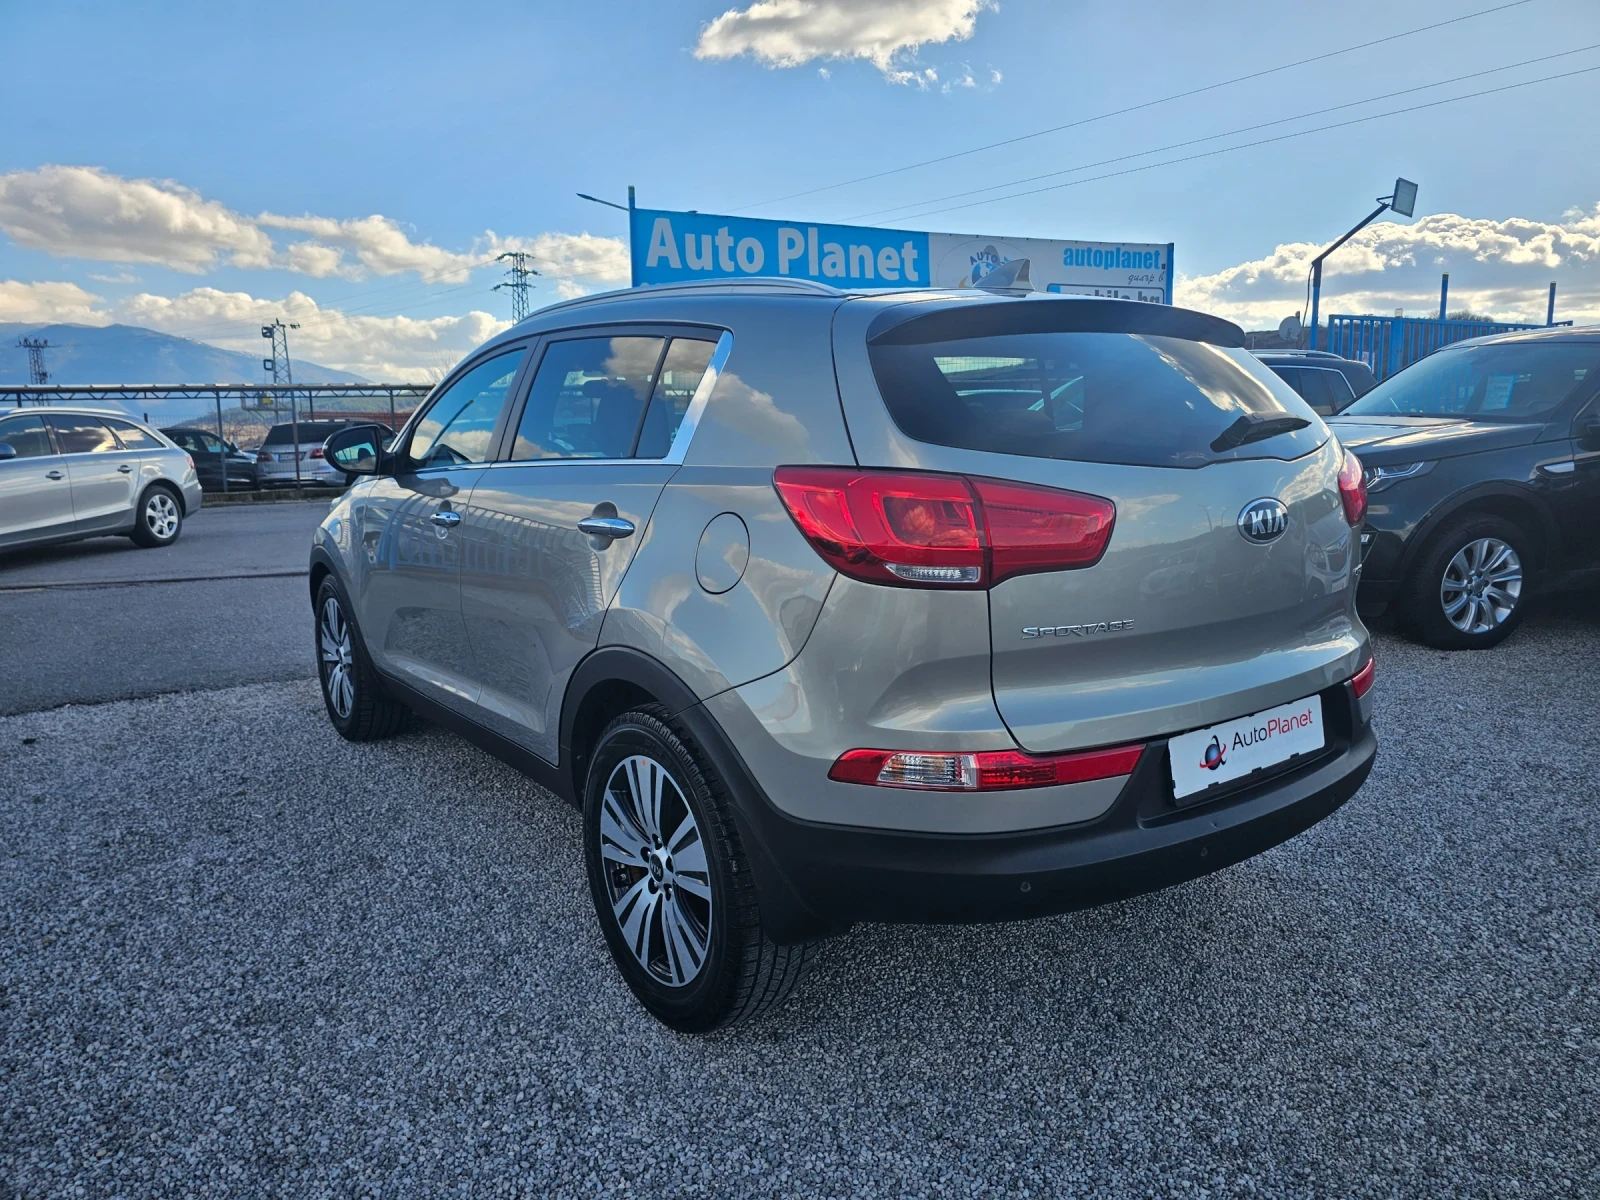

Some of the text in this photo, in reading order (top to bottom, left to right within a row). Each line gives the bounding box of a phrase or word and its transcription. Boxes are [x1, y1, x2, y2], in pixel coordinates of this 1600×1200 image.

[646, 217, 919, 282] Auto Planet
[969, 251, 998, 266] AUTO
[1249, 507, 1285, 535] KIA
[1021, 619, 1135, 640] SPORTAGE
[1232, 708, 1313, 751] AutoPlanet
